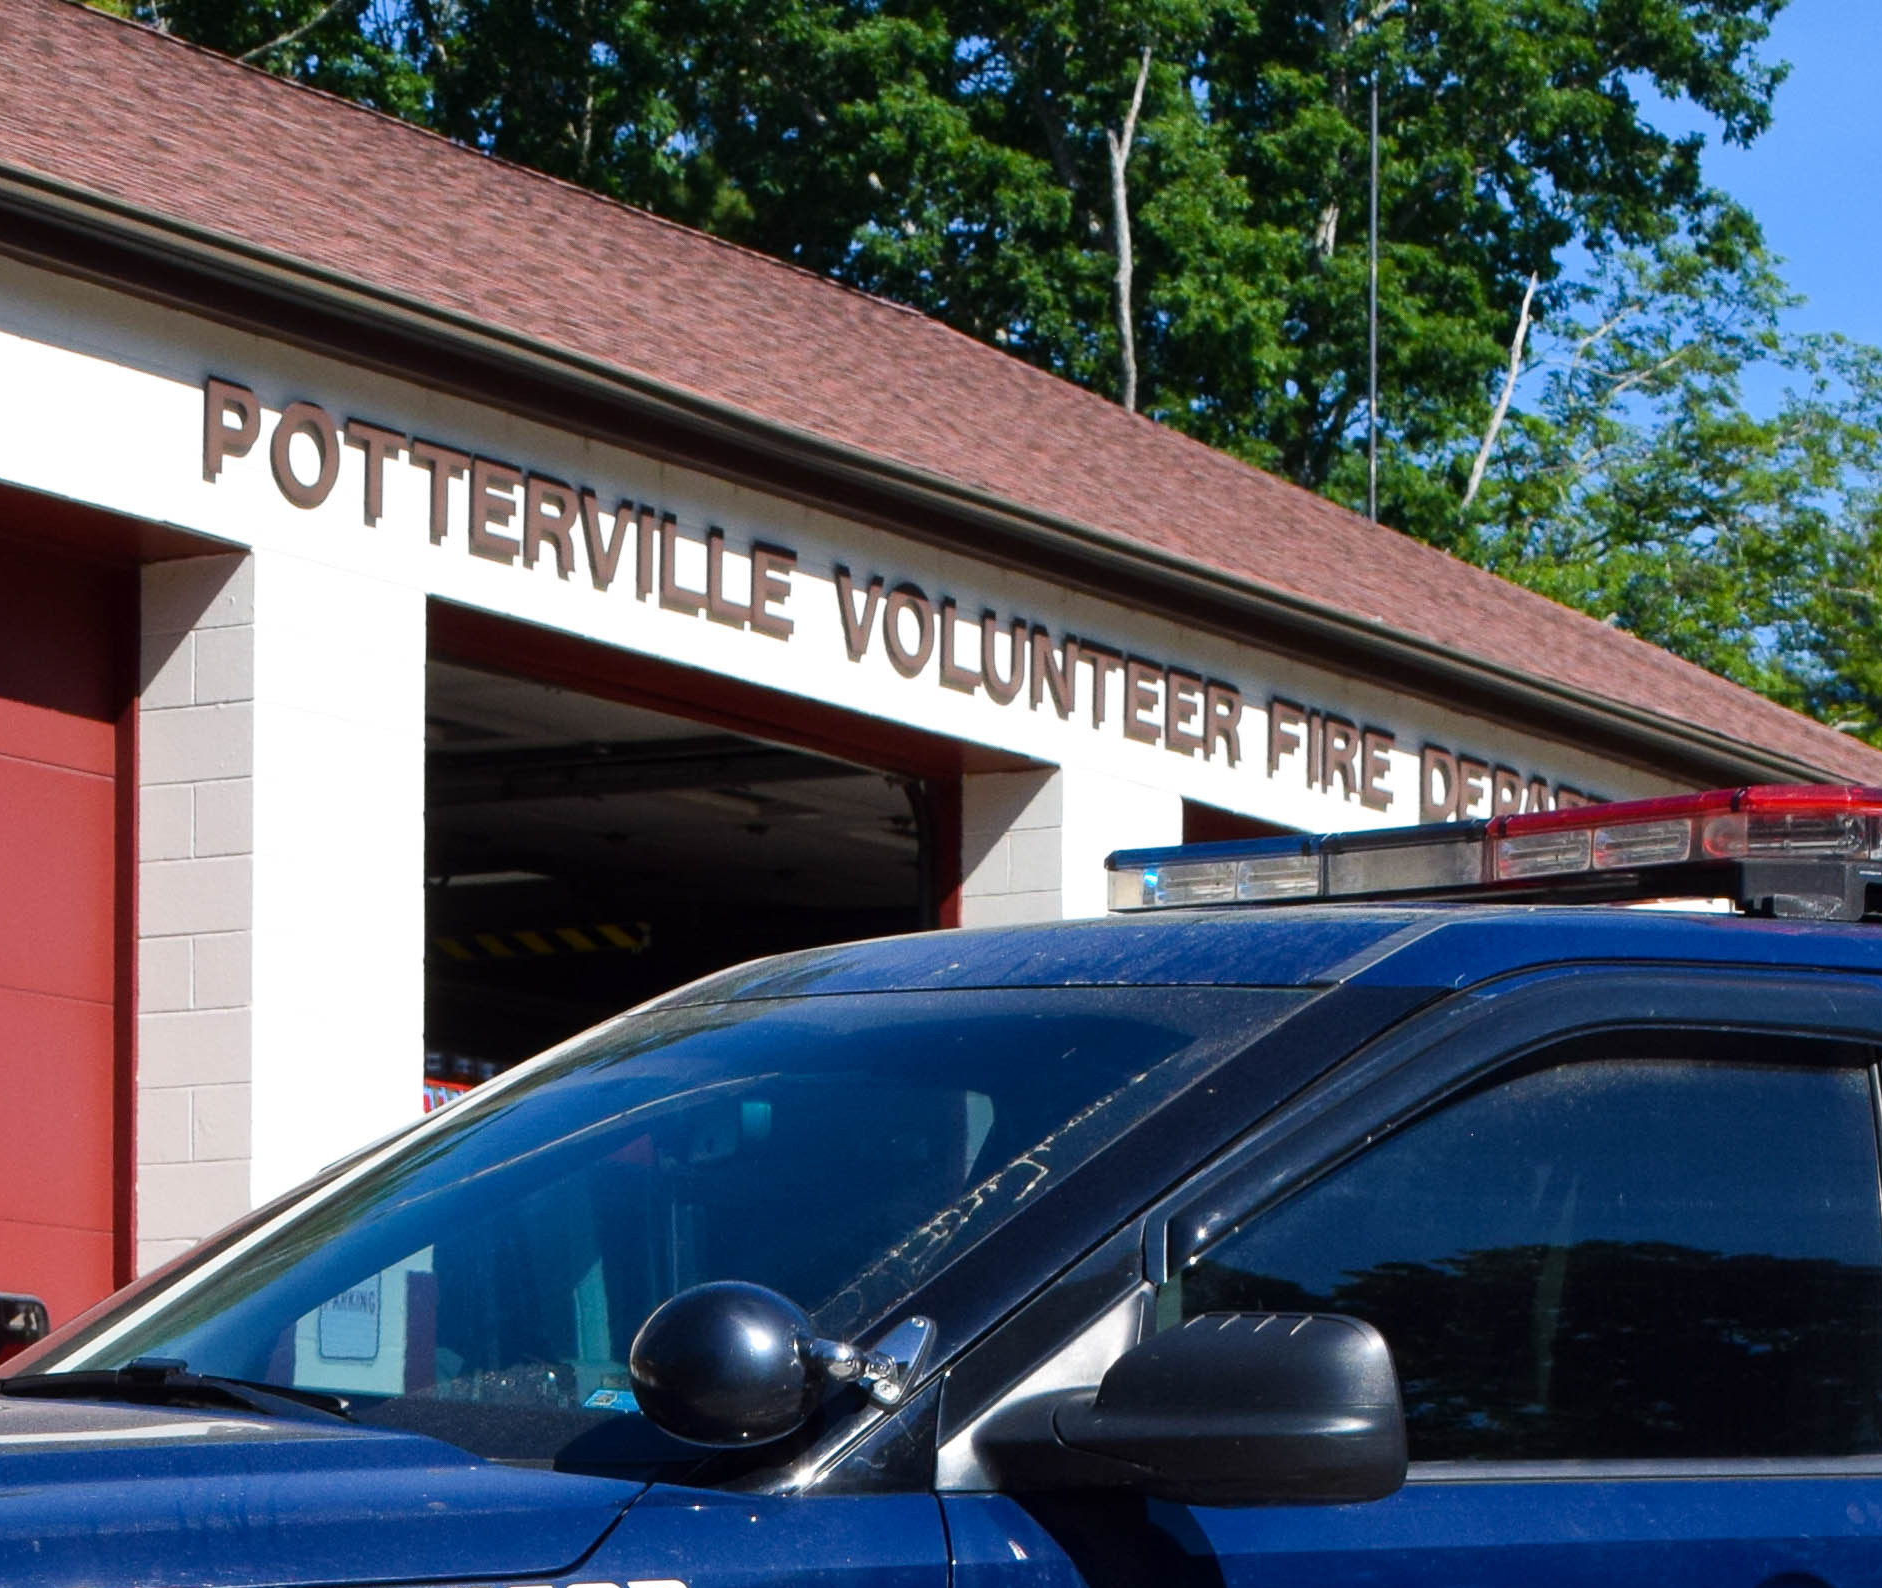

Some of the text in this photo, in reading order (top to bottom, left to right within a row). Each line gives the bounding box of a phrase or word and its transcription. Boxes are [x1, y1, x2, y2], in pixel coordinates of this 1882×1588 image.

[202, 376, 798, 641] POTTERVILLE
[835, 564, 1242, 767] VOLUNTEER
[1267, 695, 1396, 812] FIRE
